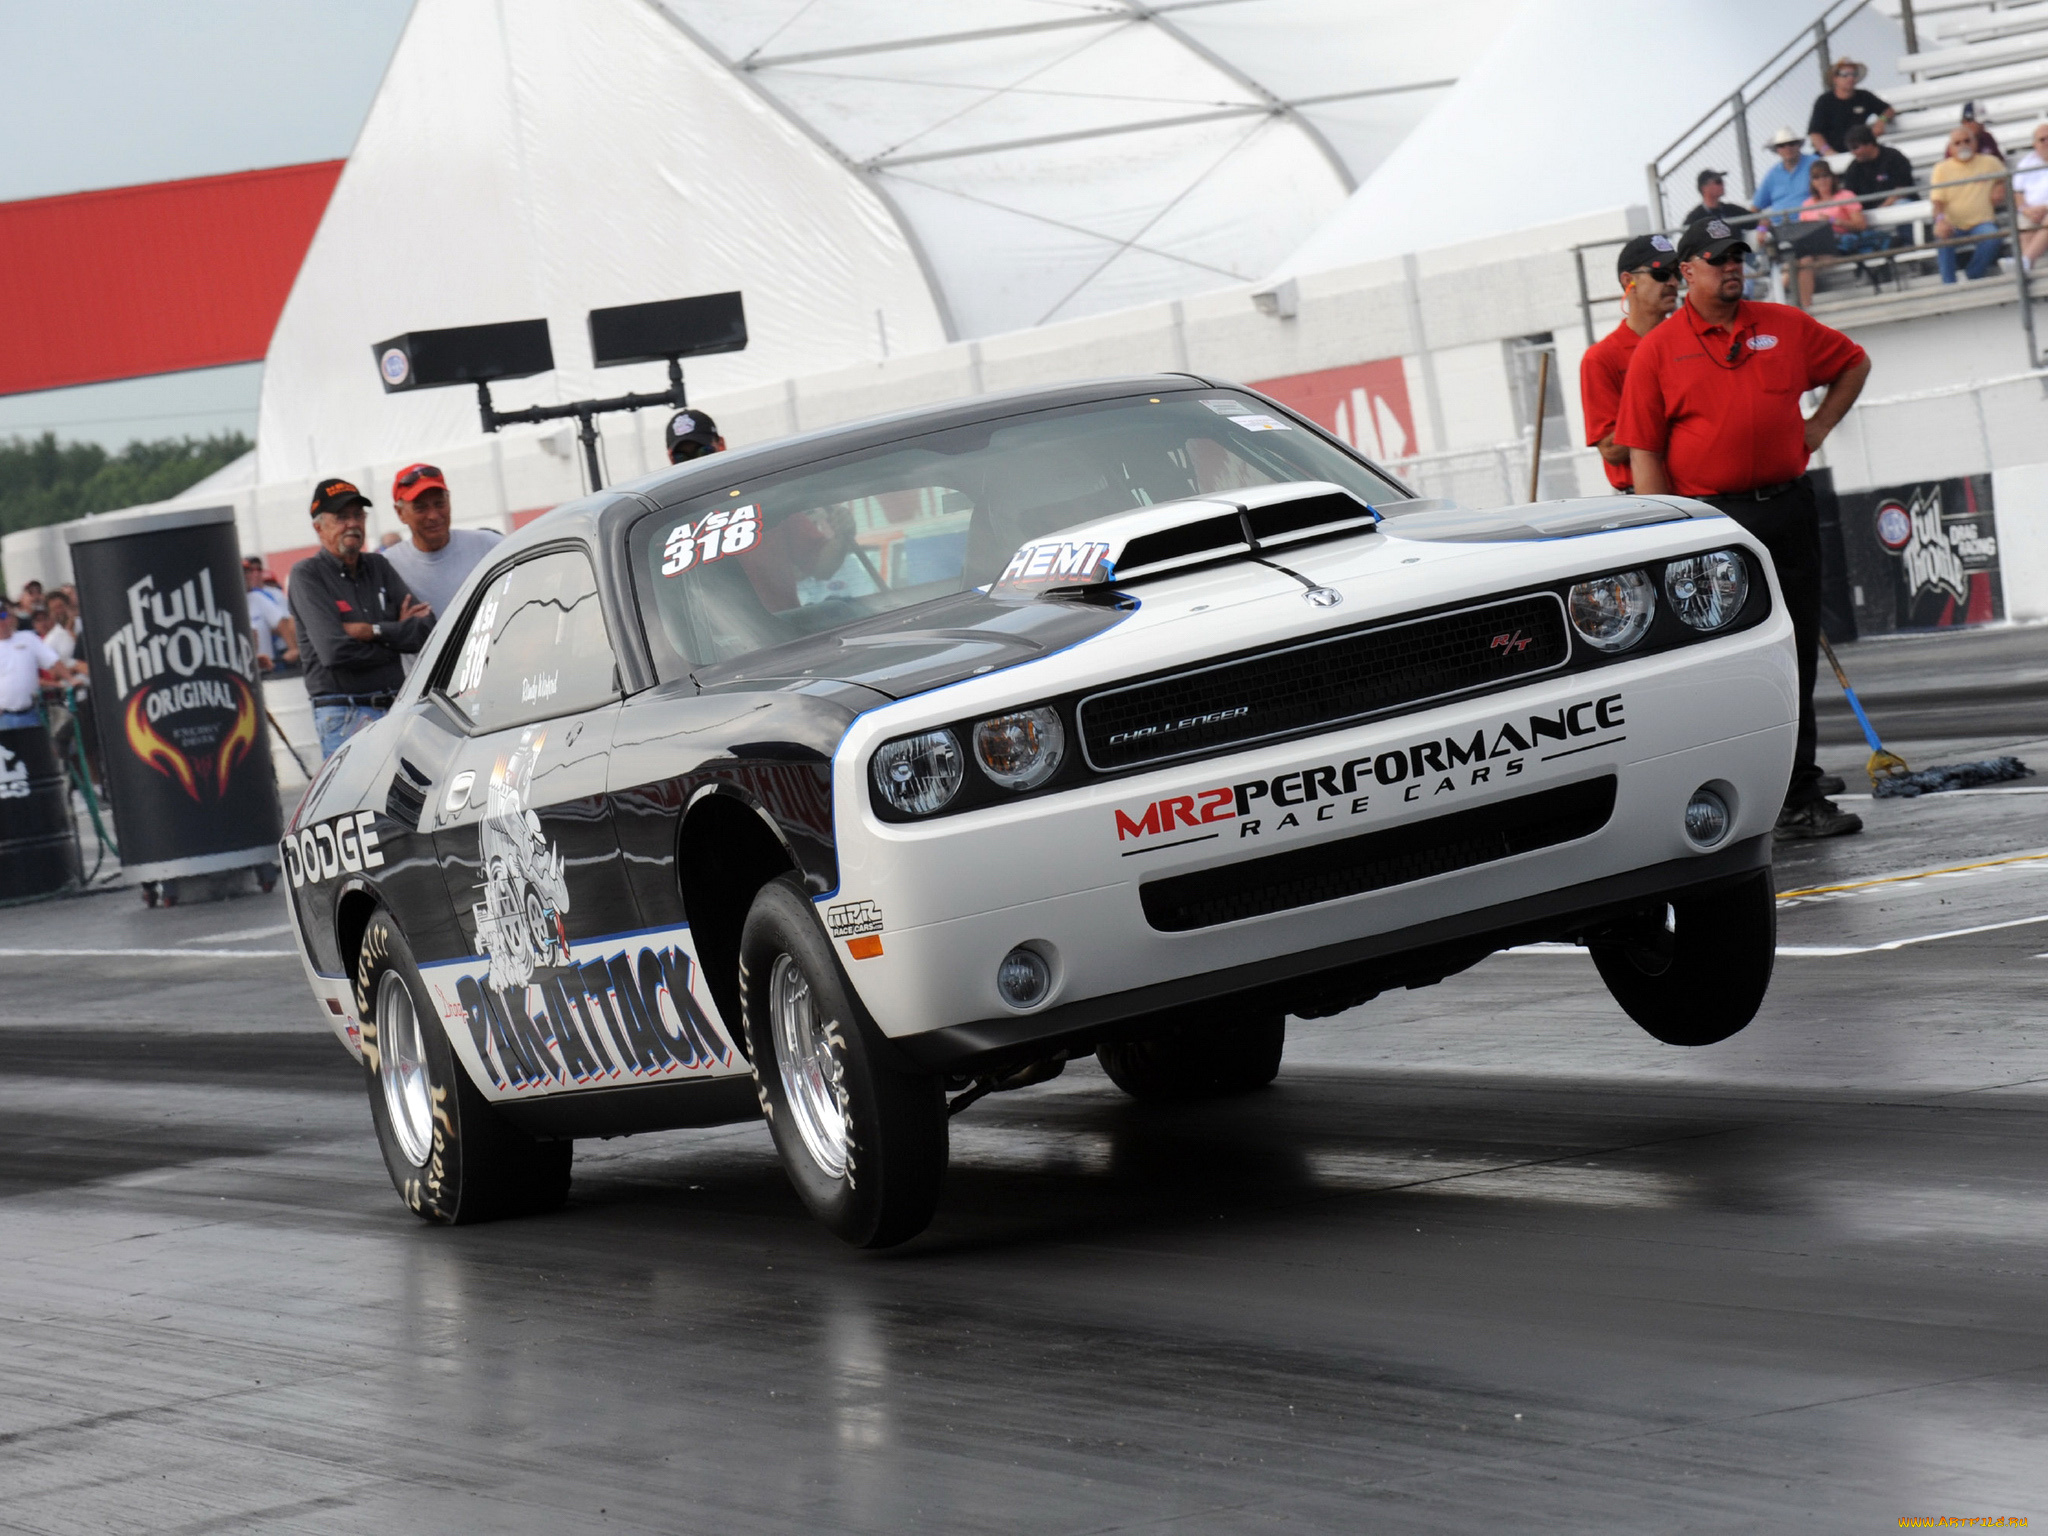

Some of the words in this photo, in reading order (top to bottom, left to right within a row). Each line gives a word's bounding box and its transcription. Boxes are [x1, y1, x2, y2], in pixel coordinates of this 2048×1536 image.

[665, 505, 756, 545] A/SA
[661, 519, 761, 577] 318
[998, 541, 1110, 585] HEMI
[459, 632, 491, 692] 318
[1490, 629, 1533, 656] R/T
[146, 679, 236, 723] ORIGINAL
[1109, 706, 1249, 745] CHALLENGER
[1114, 693, 1625, 841] MR2PERFORMANCE
[1239, 796, 1369, 838] RACE
[1404, 757, 1524, 802] CARS
[286, 810, 385, 889] DODGE
[833, 926, 854, 938] RACE
[854, 922, 874, 935] CARS
